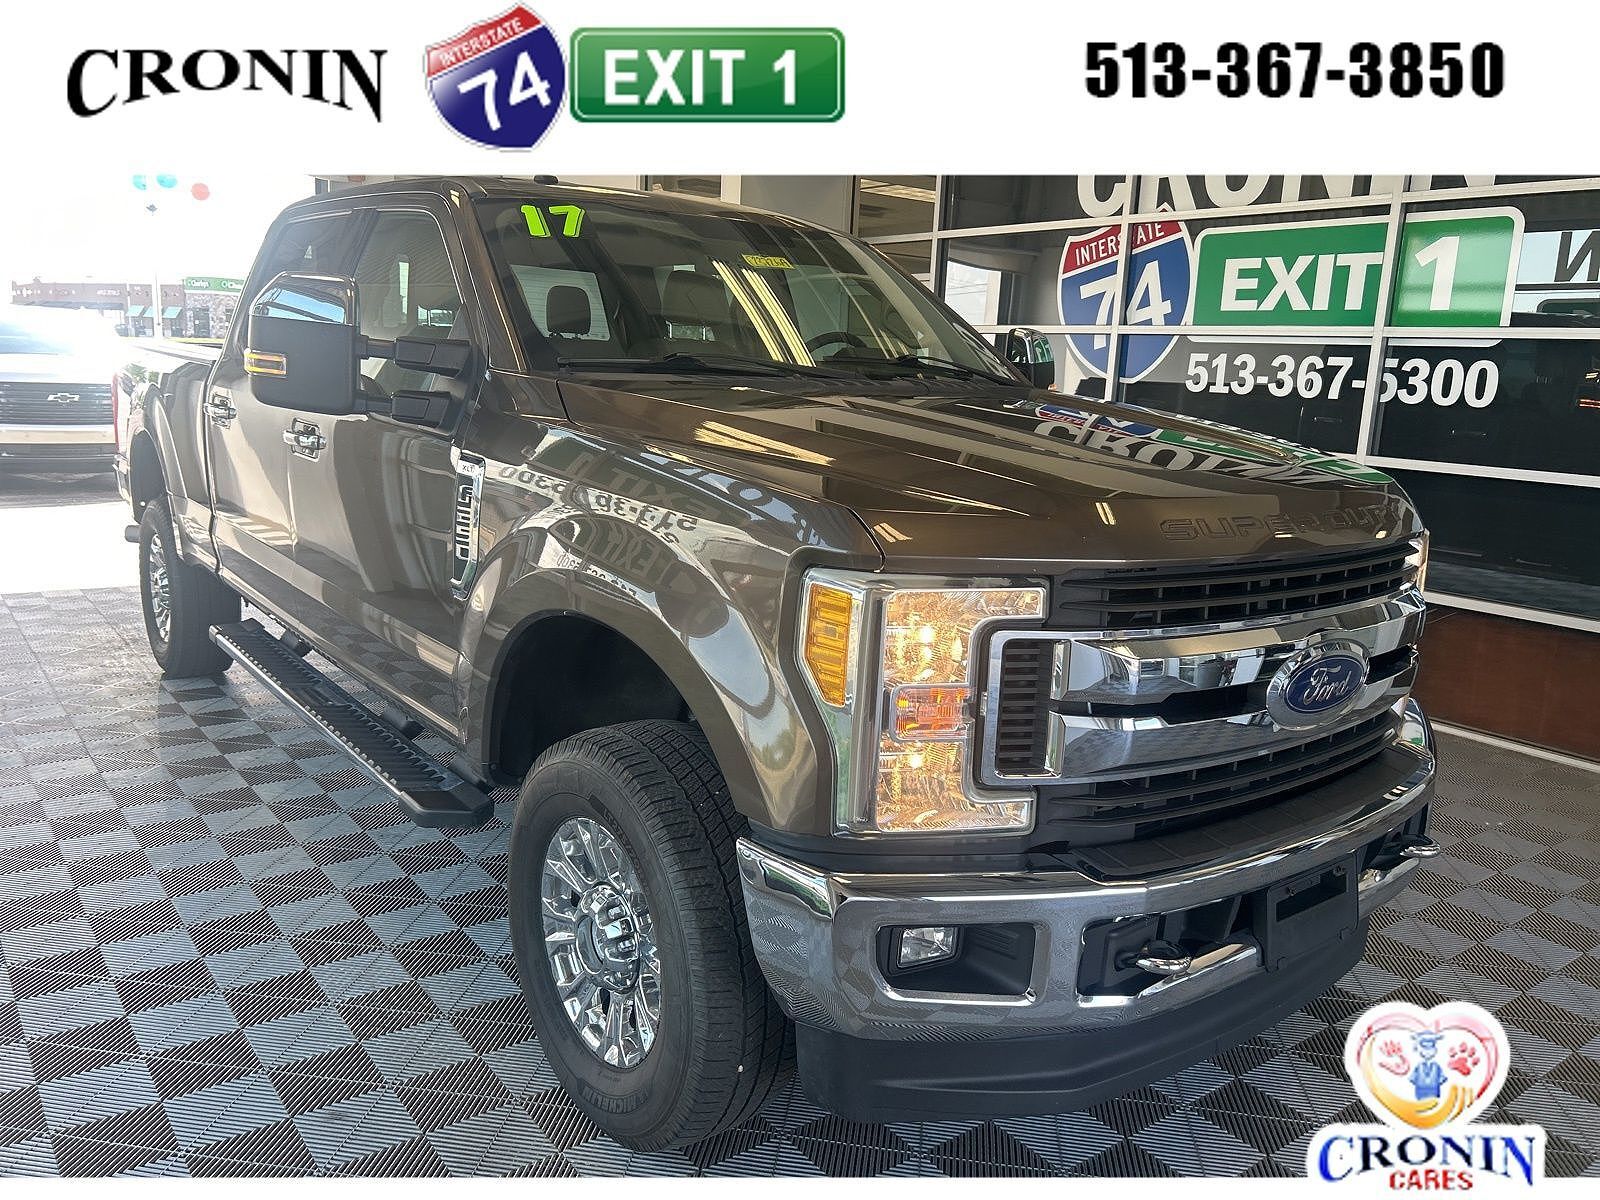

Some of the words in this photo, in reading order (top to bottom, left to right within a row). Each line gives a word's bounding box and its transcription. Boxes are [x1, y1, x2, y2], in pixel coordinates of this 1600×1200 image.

[1077, 174, 1497, 218] CRON
[520, 204, 586, 238] 17
[1075, 222, 1165, 266] INTERATE
[1220, 251, 1383, 312] EXIT
[1415, 235, 1461, 311] 1
[1079, 260, 1172, 350] 74
[1185, 352, 1499, 409] 513-367-5300
[461, 464, 474, 473] XLT
[1303, 665, 1352, 705] Ford
